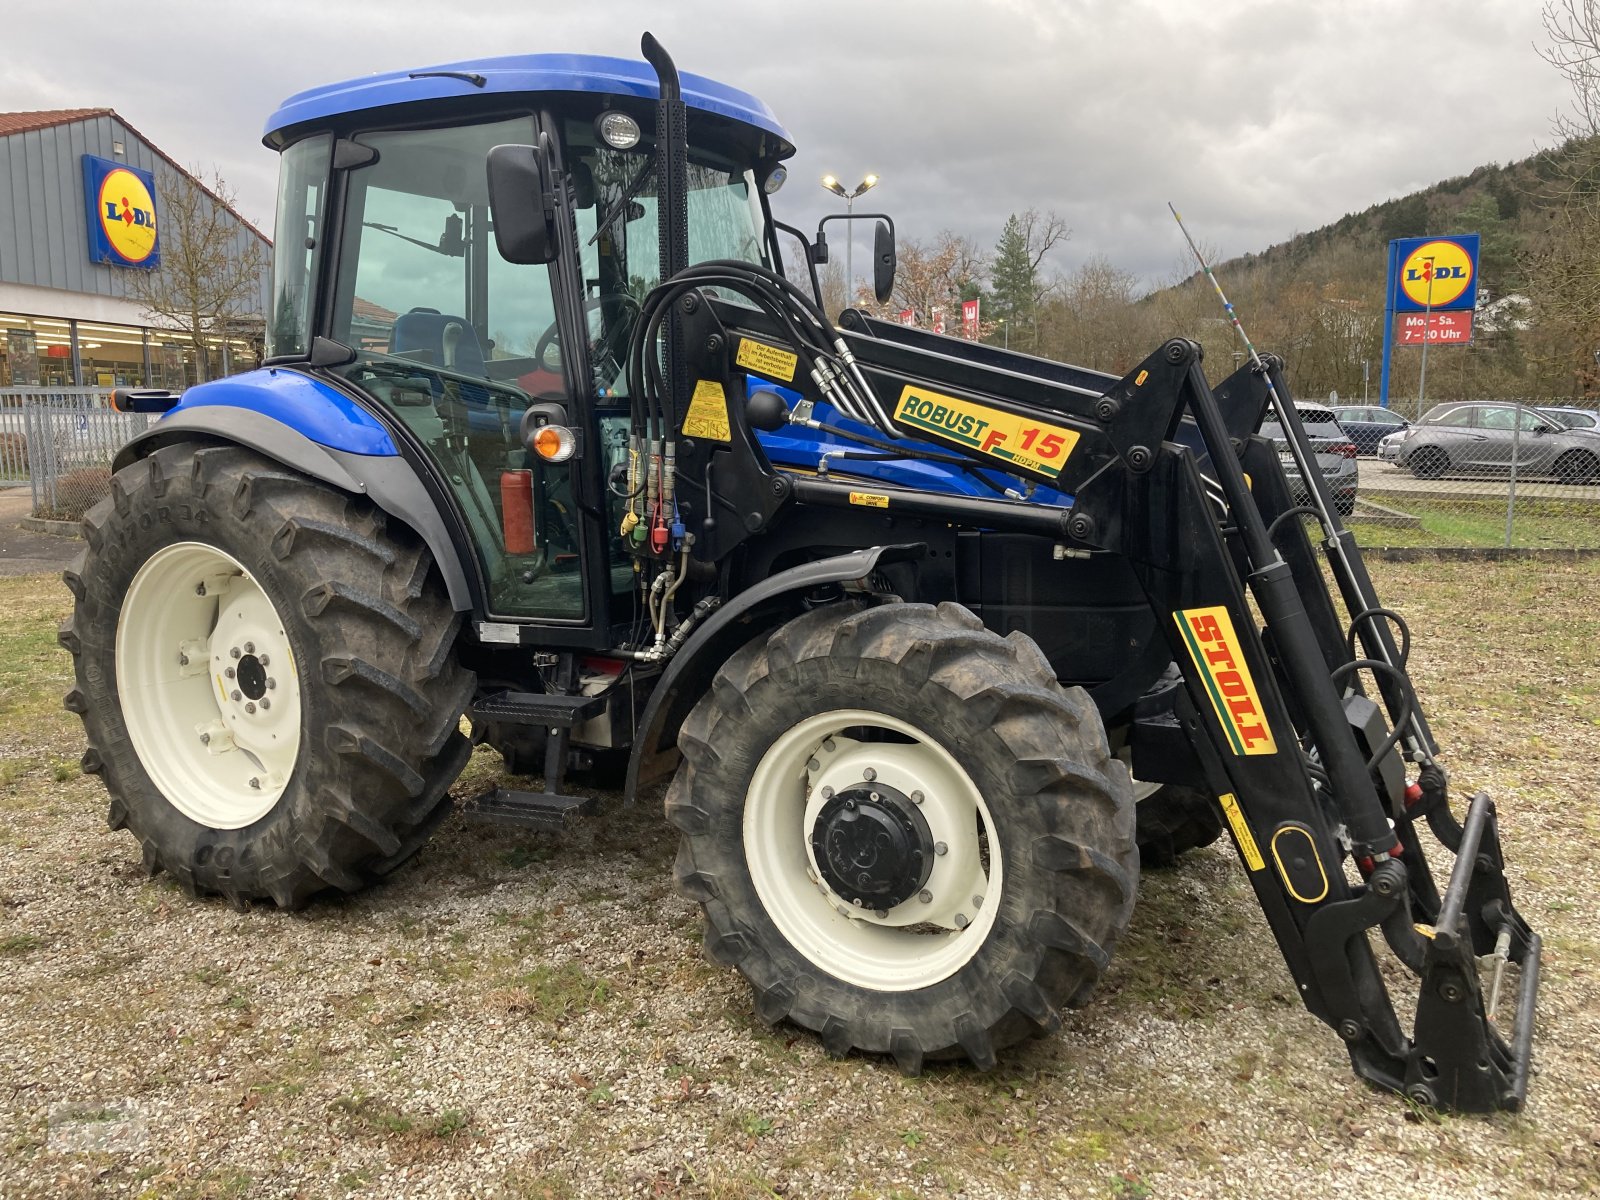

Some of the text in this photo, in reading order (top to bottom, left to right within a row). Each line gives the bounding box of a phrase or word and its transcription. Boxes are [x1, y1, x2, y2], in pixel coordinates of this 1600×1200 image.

[1439, 315, 1456, 325] Sa.
[1405, 330, 1412, 340] 7
[1440, 328, 1462, 339] Uhr
[766, 349, 792, 360] Aufenthalt
[902, 395, 1066, 460] ROBUST F 15
[1011, 454, 1041, 471] HDPM
[1190, 614, 1269, 749] STOLL
